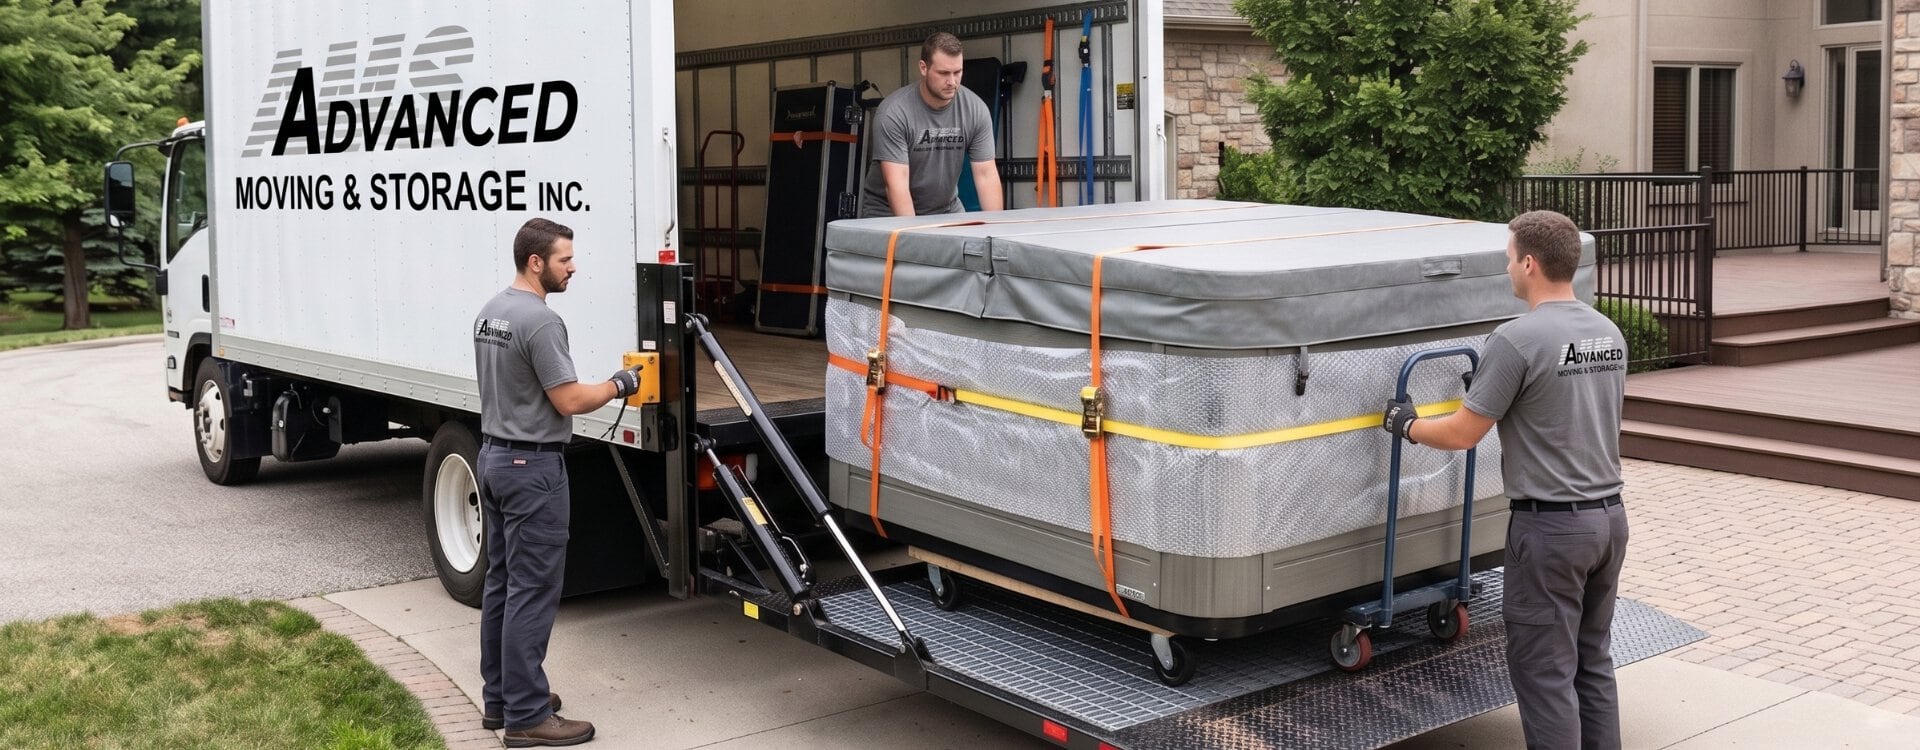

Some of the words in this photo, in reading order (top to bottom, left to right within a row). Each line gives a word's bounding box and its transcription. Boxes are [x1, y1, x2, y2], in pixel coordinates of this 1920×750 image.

[272, 67, 578, 156] ADVANCED
[236, 175, 333, 210] MOVING
[343, 174, 361, 210] &
[370, 170, 526, 211] STORAGE
[539, 182, 590, 211] INC.
[1557, 367, 1583, 377] MOVING
[1589, 364, 1618, 374] STORAGE
[1564, 343, 1622, 366] ADVANCED
